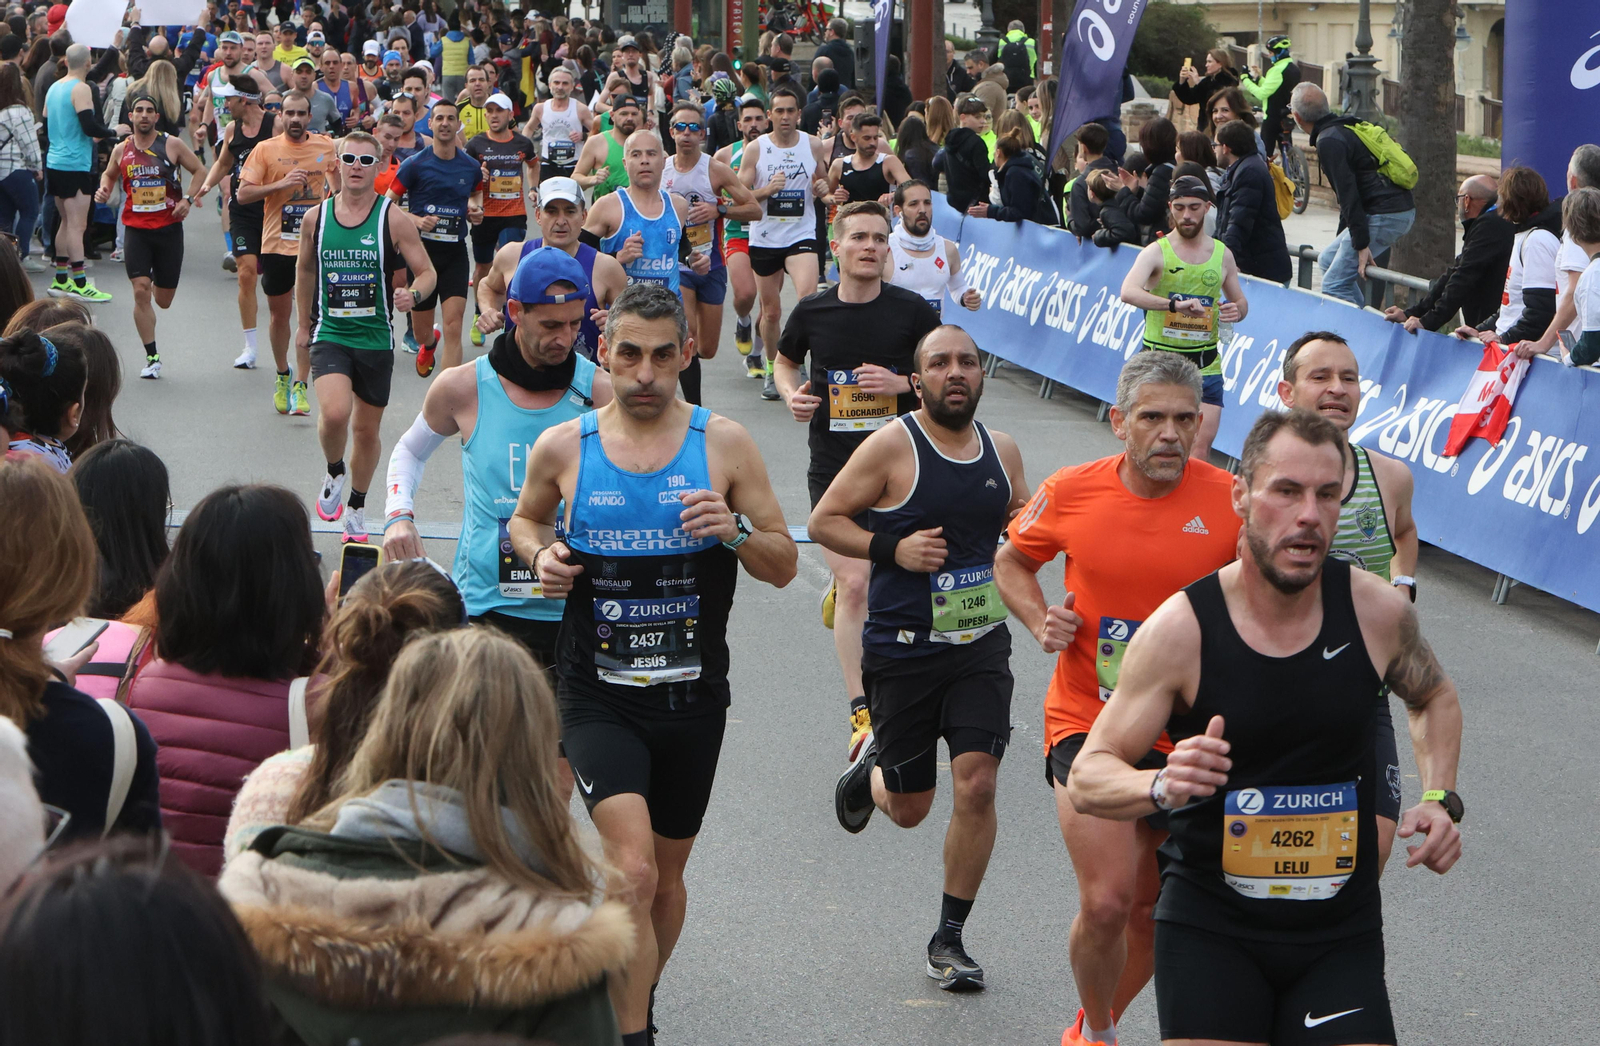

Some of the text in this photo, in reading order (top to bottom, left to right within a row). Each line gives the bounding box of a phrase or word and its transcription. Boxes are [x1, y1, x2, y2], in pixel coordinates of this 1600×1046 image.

[733, 1, 742, 34] PASEO
[1127, 0, 1141, 25] soun
[322, 250, 377, 260] CHILTERN
[342, 288, 360, 296] 2345
[1000, 264, 1043, 317] asics
[1045, 278, 1088, 333] asics
[1092, 294, 1137, 351] asics
[1503, 429, 1588, 516] asics
[852, 392, 876, 402] 5696
[846, 406, 890, 418] LOCHARDET
[588, 496, 626, 506] MUNDO
[586, 528, 693, 540] TRIATLO
[1182, 526, 1209, 535] adidas
[510, 570, 532, 580] ENA
[960, 568, 992, 585] ZURICH
[592, 577, 632, 588] BAÑOSALUD
[656, 578, 696, 587] Gestinver
[960, 595, 986, 610] 1246
[630, 602, 686, 618] ZURICH
[958, 614, 989, 629] DIPESH
[629, 632, 664, 648] 2437
[630, 655, 667, 669] JESÚS
[1273, 791, 1342, 808] ZURICH
[1270, 830, 1314, 848] 4262
[1274, 861, 1310, 874] LELU
